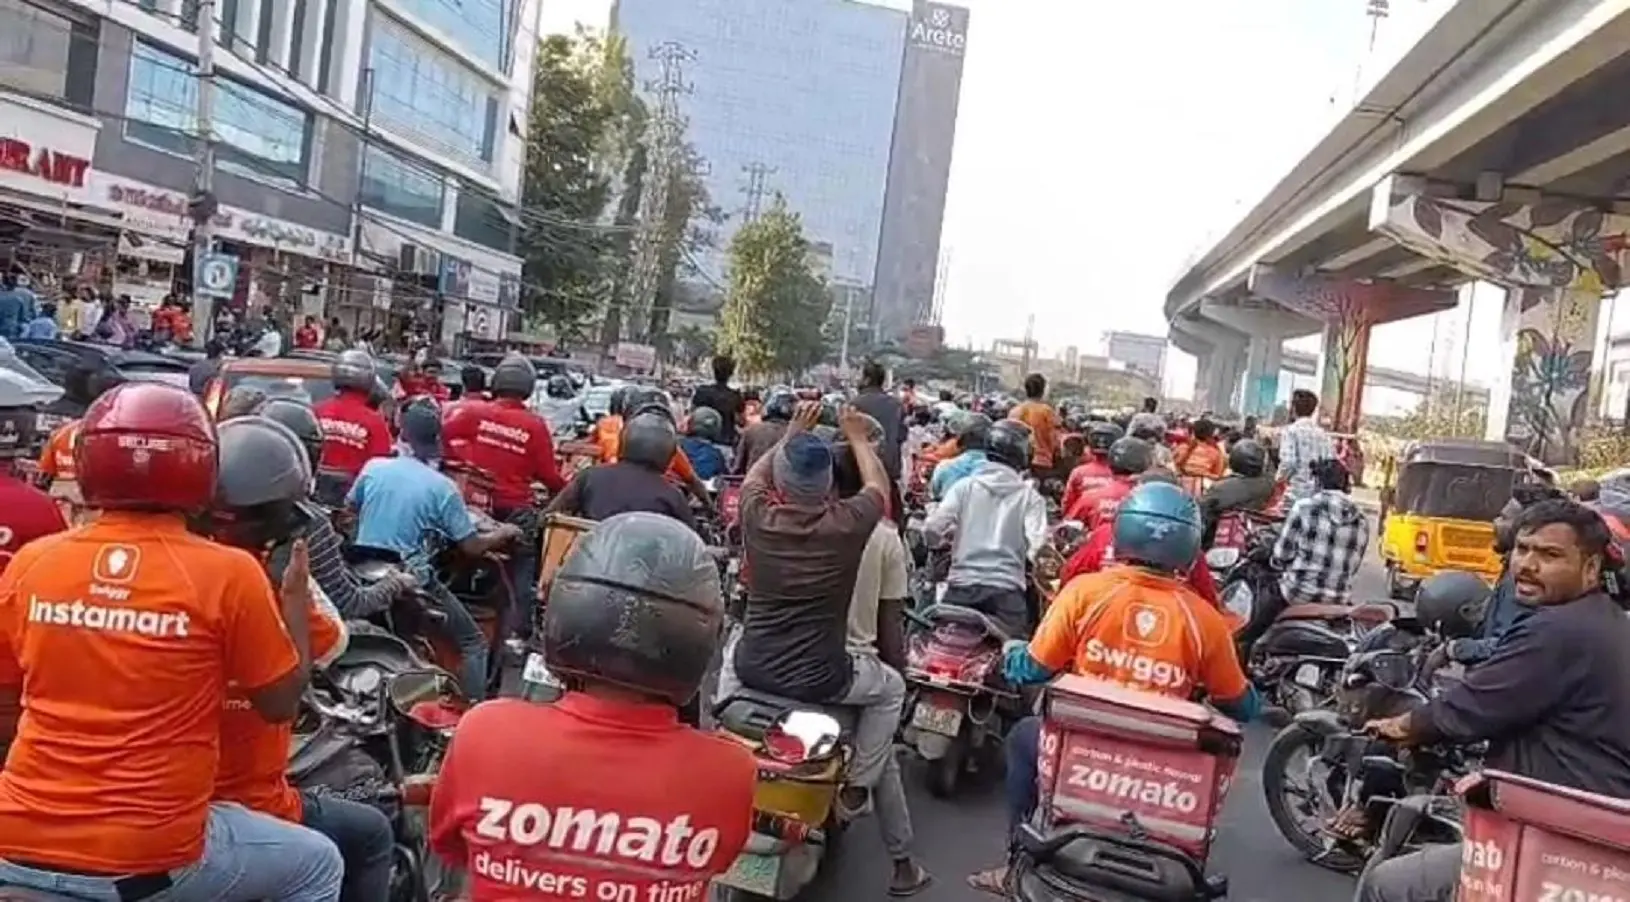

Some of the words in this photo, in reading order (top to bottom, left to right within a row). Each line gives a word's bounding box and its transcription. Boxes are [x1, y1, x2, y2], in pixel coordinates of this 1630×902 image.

[28, 594, 190, 637] Instamart
[1086, 638, 1187, 688] Swiggy
[1068, 764, 1197, 813] zomato
[476, 796, 720, 868] zomato
[475, 851, 588, 898] delivers
[596, 881, 638, 902] on
[1541, 852, 1587, 873] carbon
